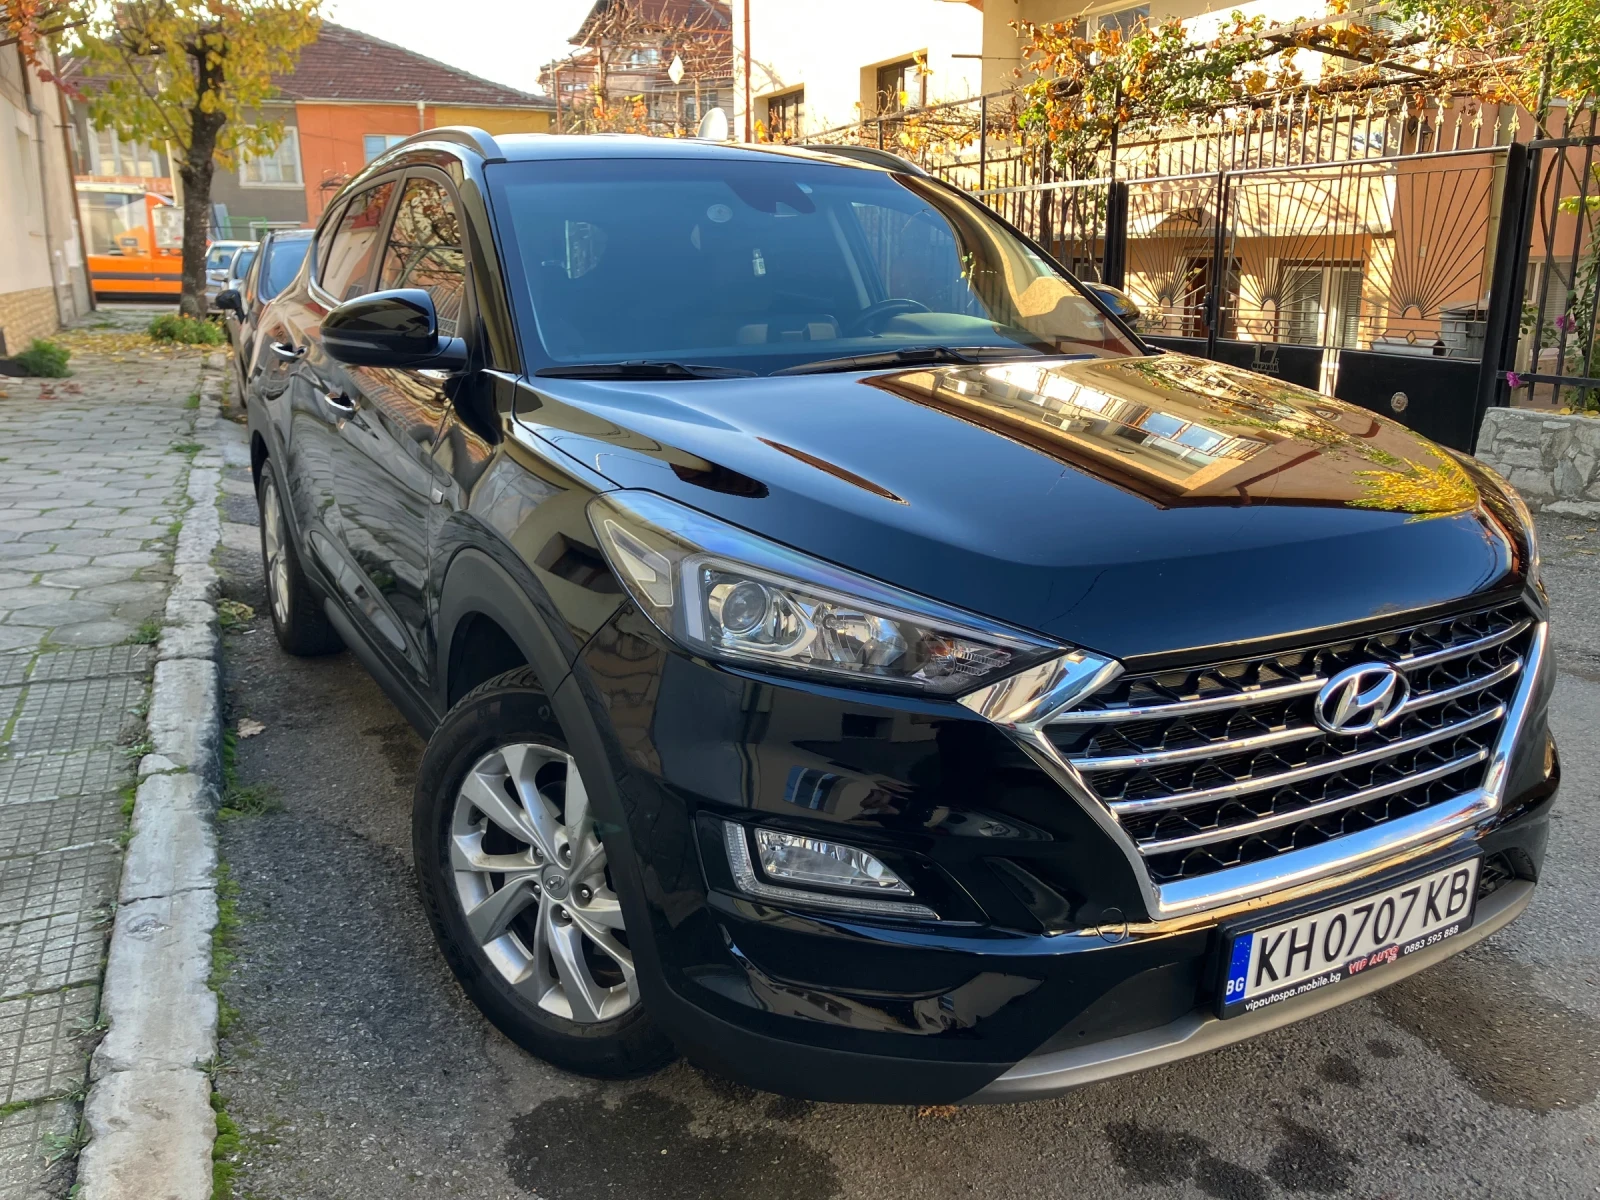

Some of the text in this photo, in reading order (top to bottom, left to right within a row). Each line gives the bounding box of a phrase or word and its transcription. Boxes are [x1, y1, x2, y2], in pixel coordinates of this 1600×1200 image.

[1226, 977, 1245, 996] BG
[1245, 925, 1459, 1011] vipautospa.mobile.bg VIP AUTO 0883 595 888
